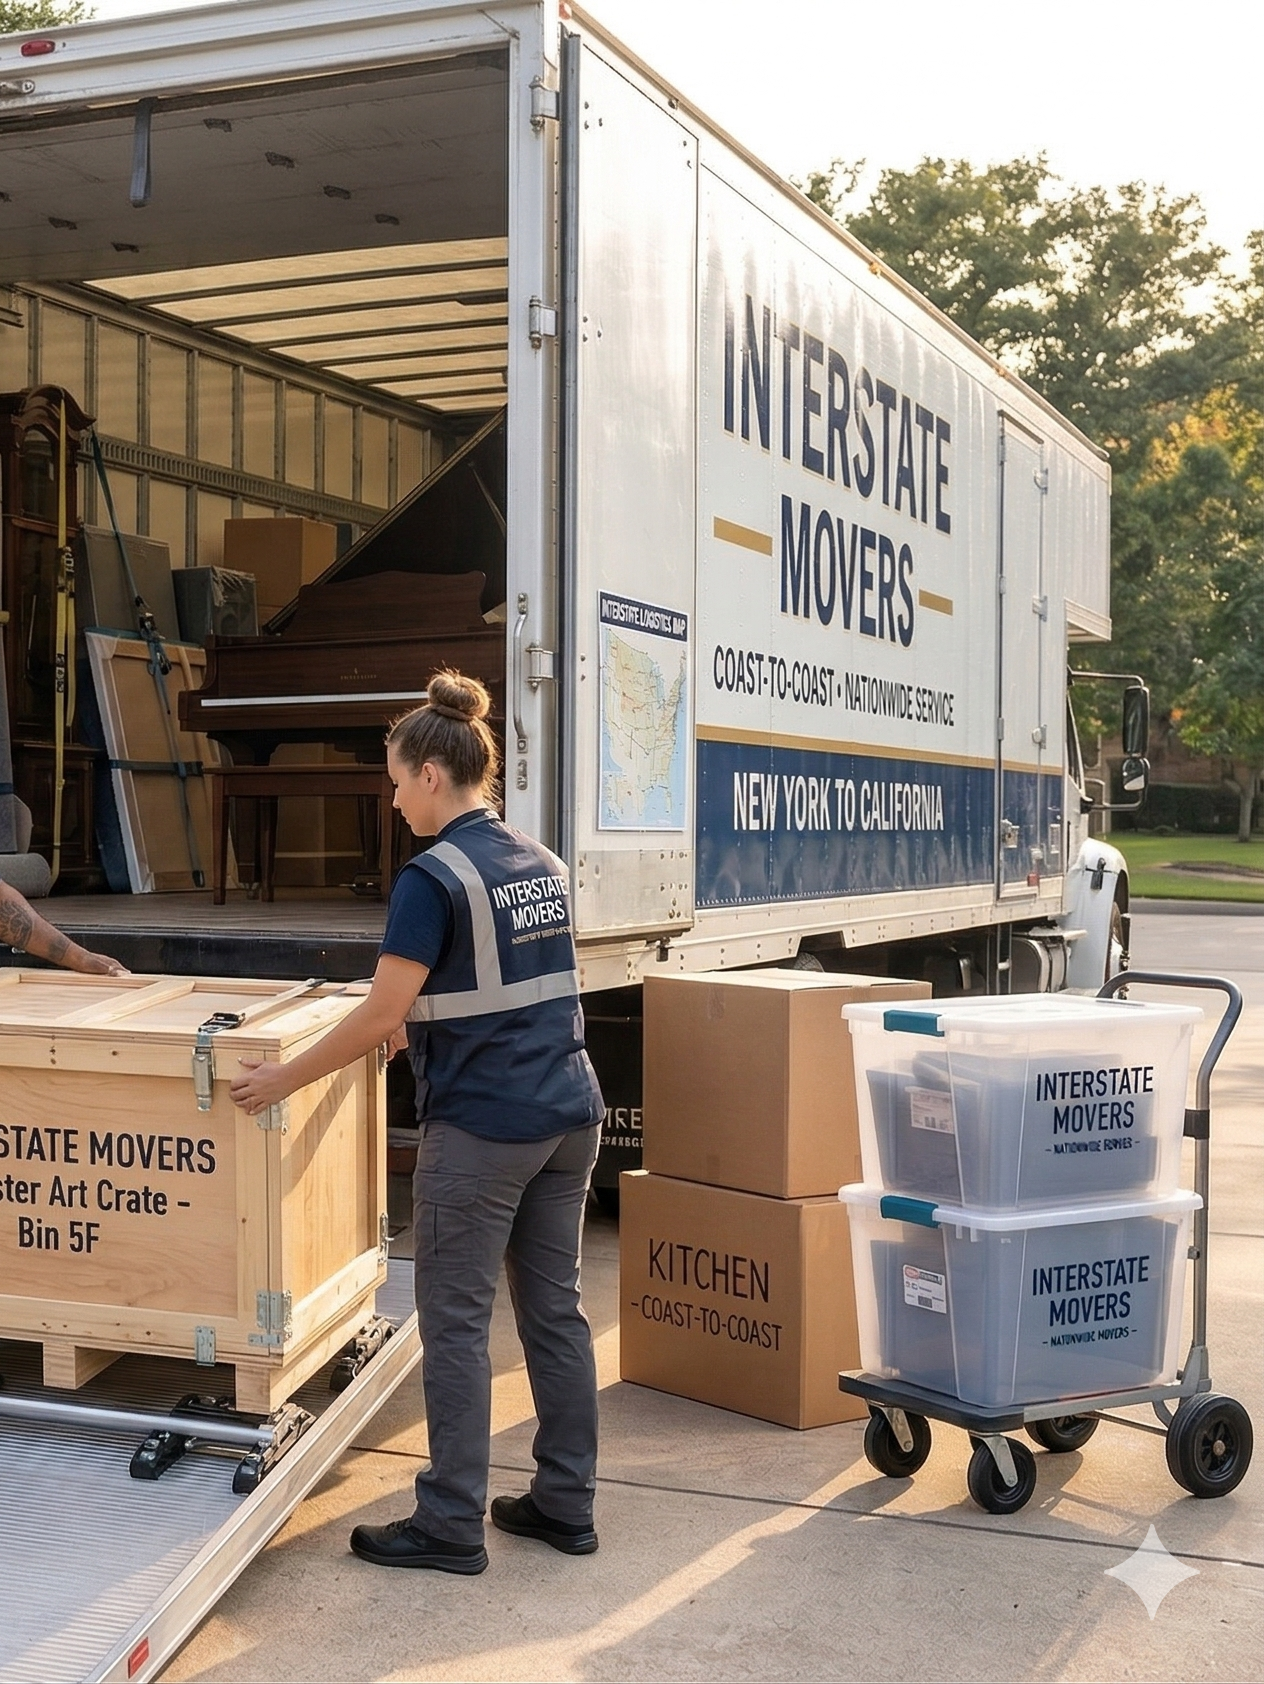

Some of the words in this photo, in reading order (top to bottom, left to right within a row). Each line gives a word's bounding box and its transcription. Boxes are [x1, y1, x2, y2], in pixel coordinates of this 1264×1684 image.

[724, 291, 951, 534] INTERSTATE
[781, 494, 913, 648] MOVERS
[713, 645, 834, 706] COAST-TO-COAST
[845, 672, 913, 720] NATIONWIDE
[915, 686, 954, 726] SERVICE
[734, 772, 779, 830] NEW
[783, 775, 831, 830] YORK
[835, 779, 855, 830] TO
[860, 780, 944, 830] CALIFORNIA
[492, 875, 568, 909] INTERSTATE
[511, 899, 565, 930] MOVERS
[1036, 1066, 1154, 1101] INTERSTATE
[1053, 1101, 1134, 1134] MOVERS
[89, 1131, 216, 1174] MOVERS
[49, 1175, 87, 1209] Art
[97, 1179, 168, 1216] Crate
[18, 1216, 59, 1250] Bin
[69, 1221, 100, 1253] 5F
[650, 1238, 769, 1303] KITCHEN
[1032, 1255, 1150, 1296] INTERSTATE
[1049, 1291, 1131, 1327] MOVERS
